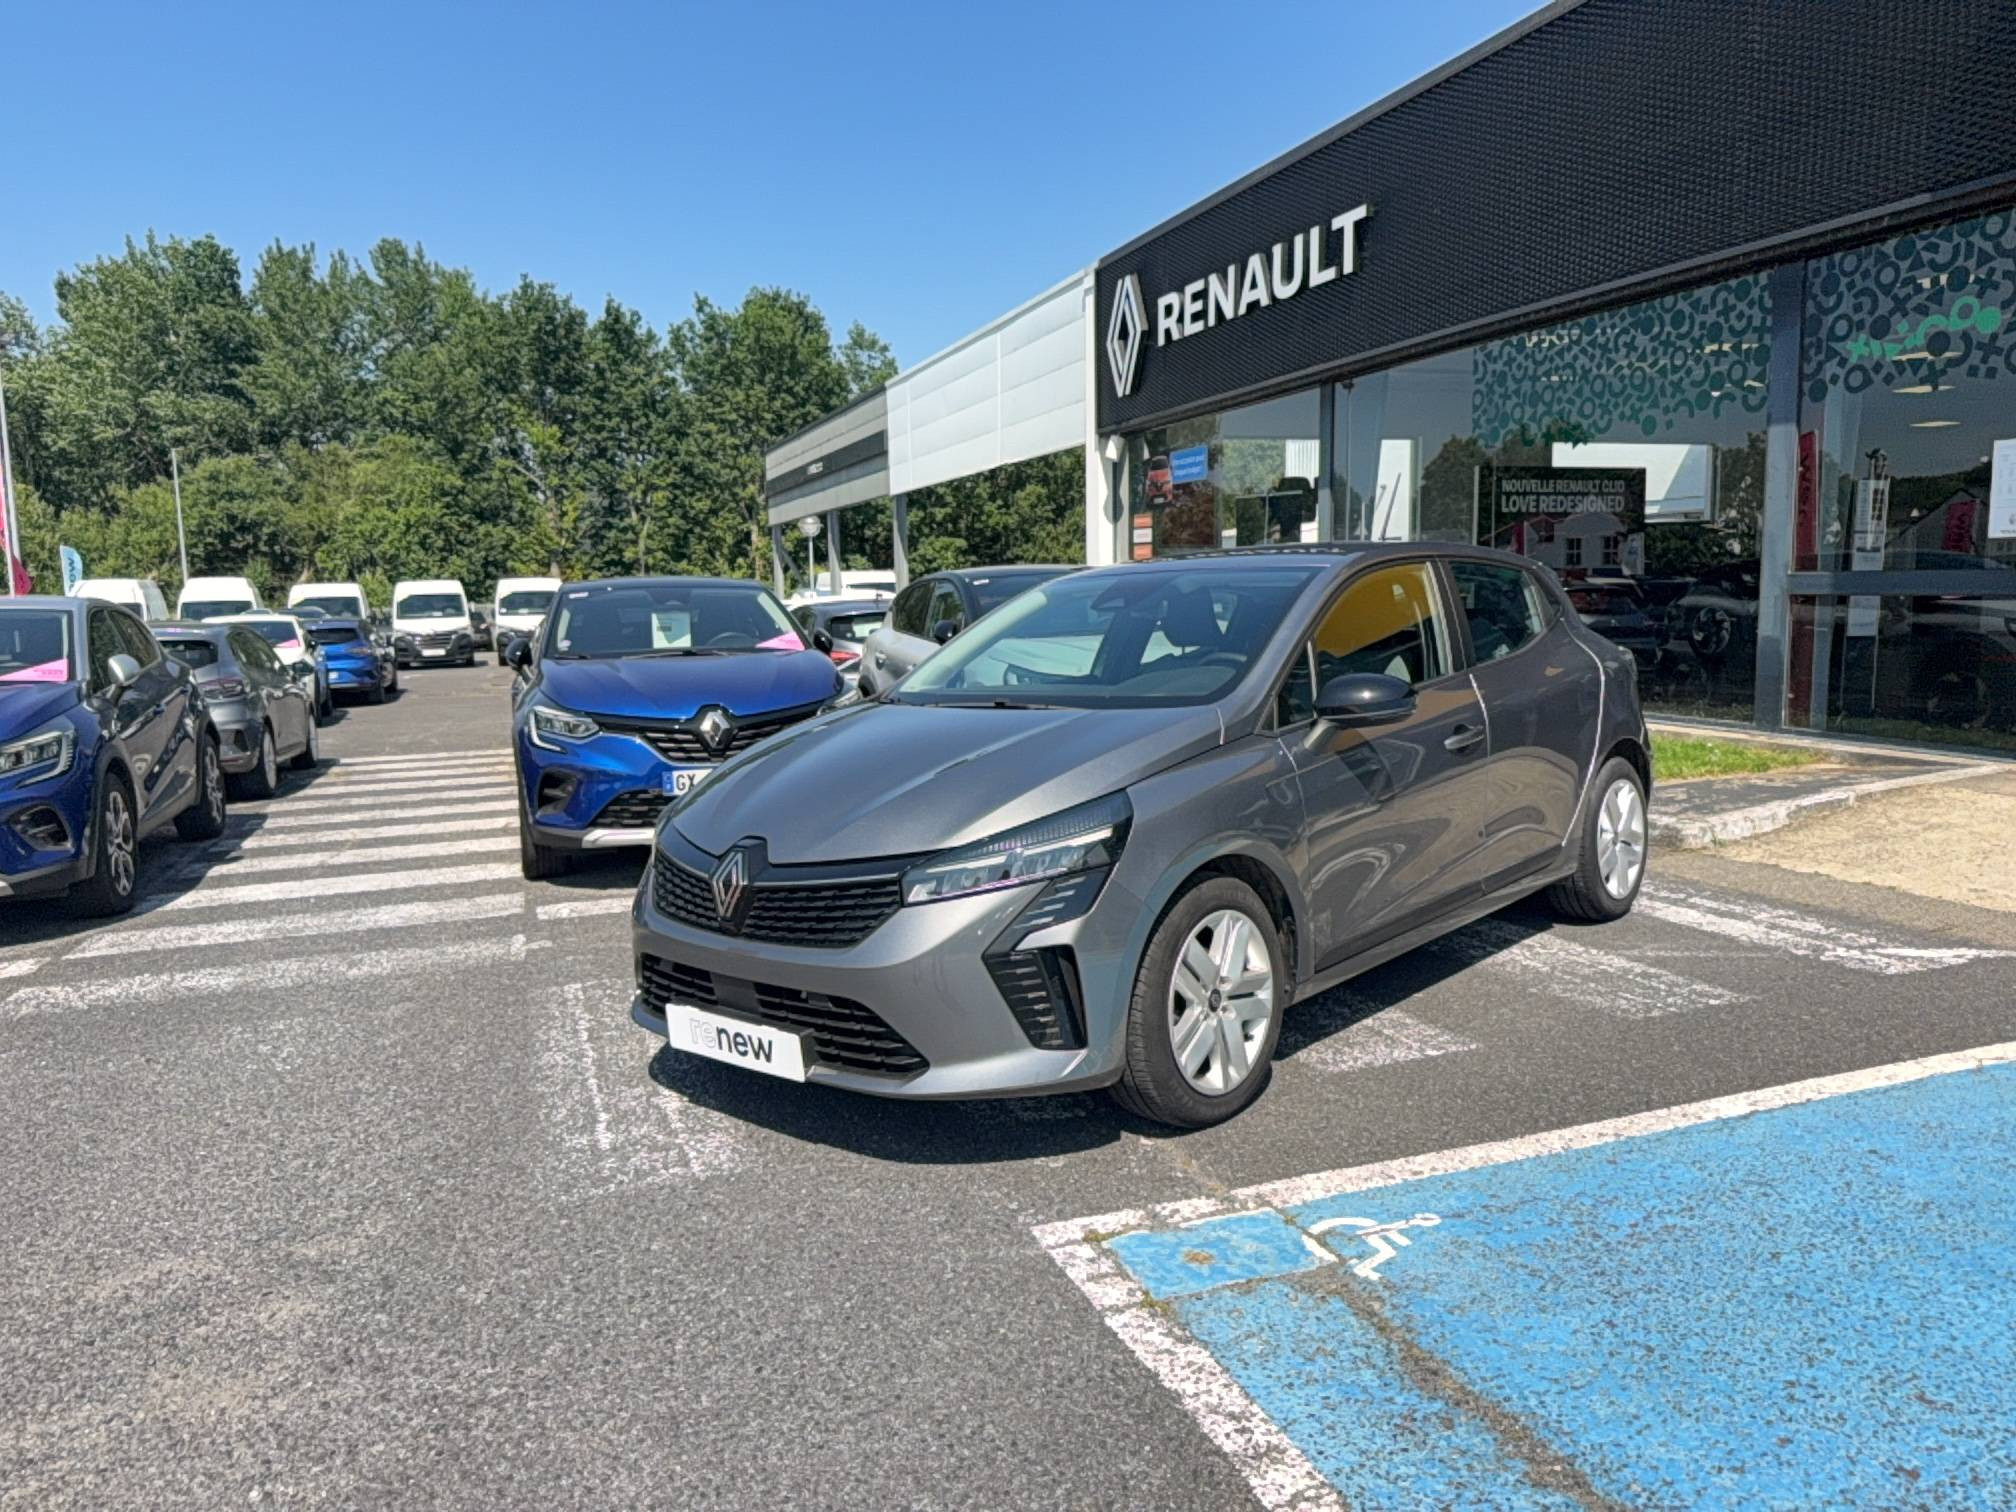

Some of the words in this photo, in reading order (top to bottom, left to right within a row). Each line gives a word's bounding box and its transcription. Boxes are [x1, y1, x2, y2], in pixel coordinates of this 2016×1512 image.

[1156, 203, 1370, 347] RENAULT
[1501, 479, 1554, 493] NOUVELLE
[1556, 479, 1600, 493] RENAULT
[1602, 479, 1625, 493] CLIO
[1501, 495, 1537, 513] LOVE
[1538, 495, 1625, 513] REDESIGNED
[689, 1016, 773, 1064] renew
